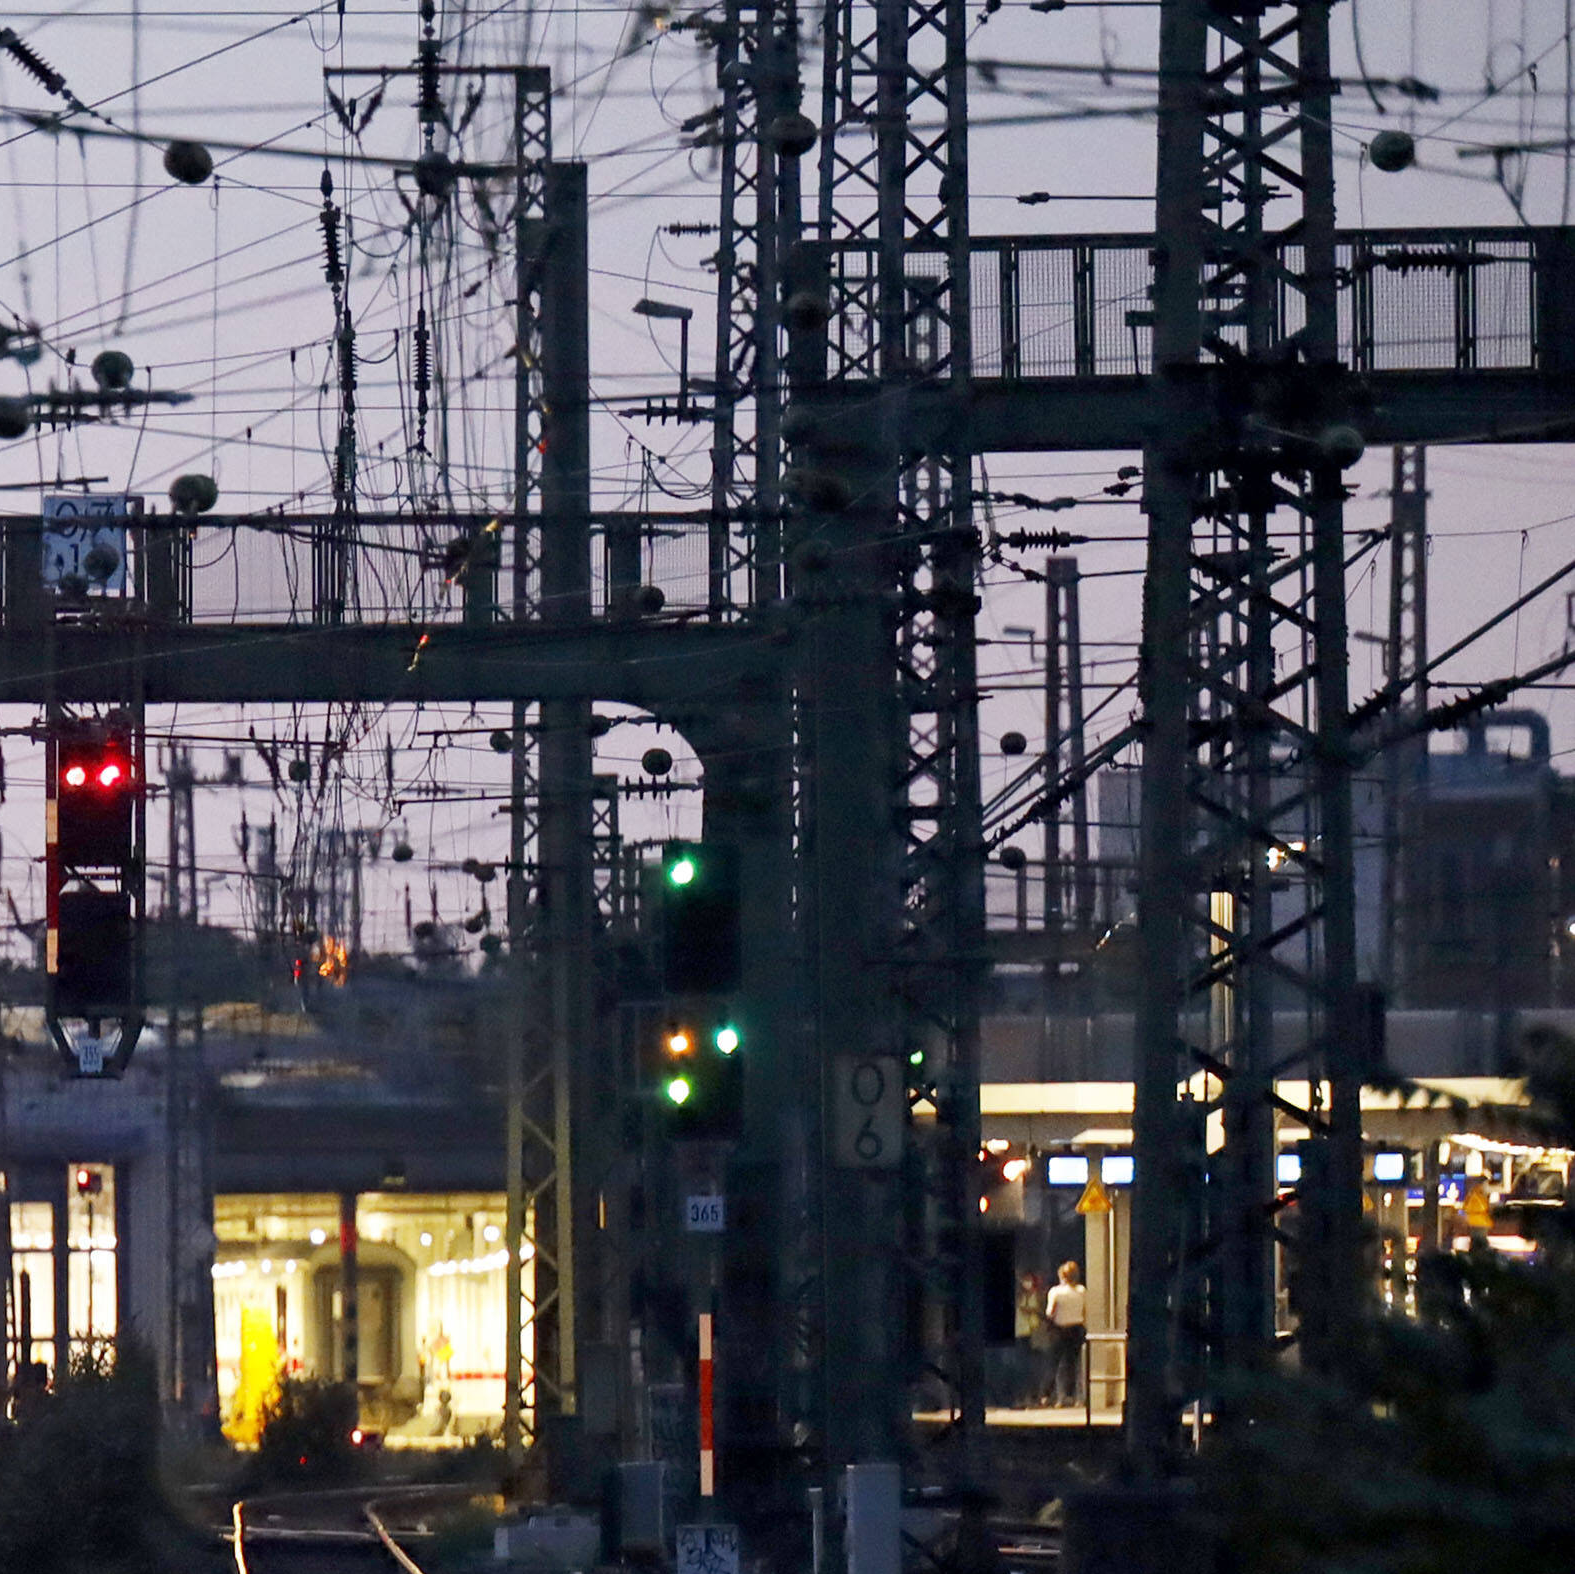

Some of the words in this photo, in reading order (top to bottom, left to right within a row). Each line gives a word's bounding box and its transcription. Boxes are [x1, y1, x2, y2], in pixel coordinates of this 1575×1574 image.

[851, 1063, 885, 1106] 0
[855, 1115, 883, 1160] 6
[691, 1203, 719, 1222] 365
